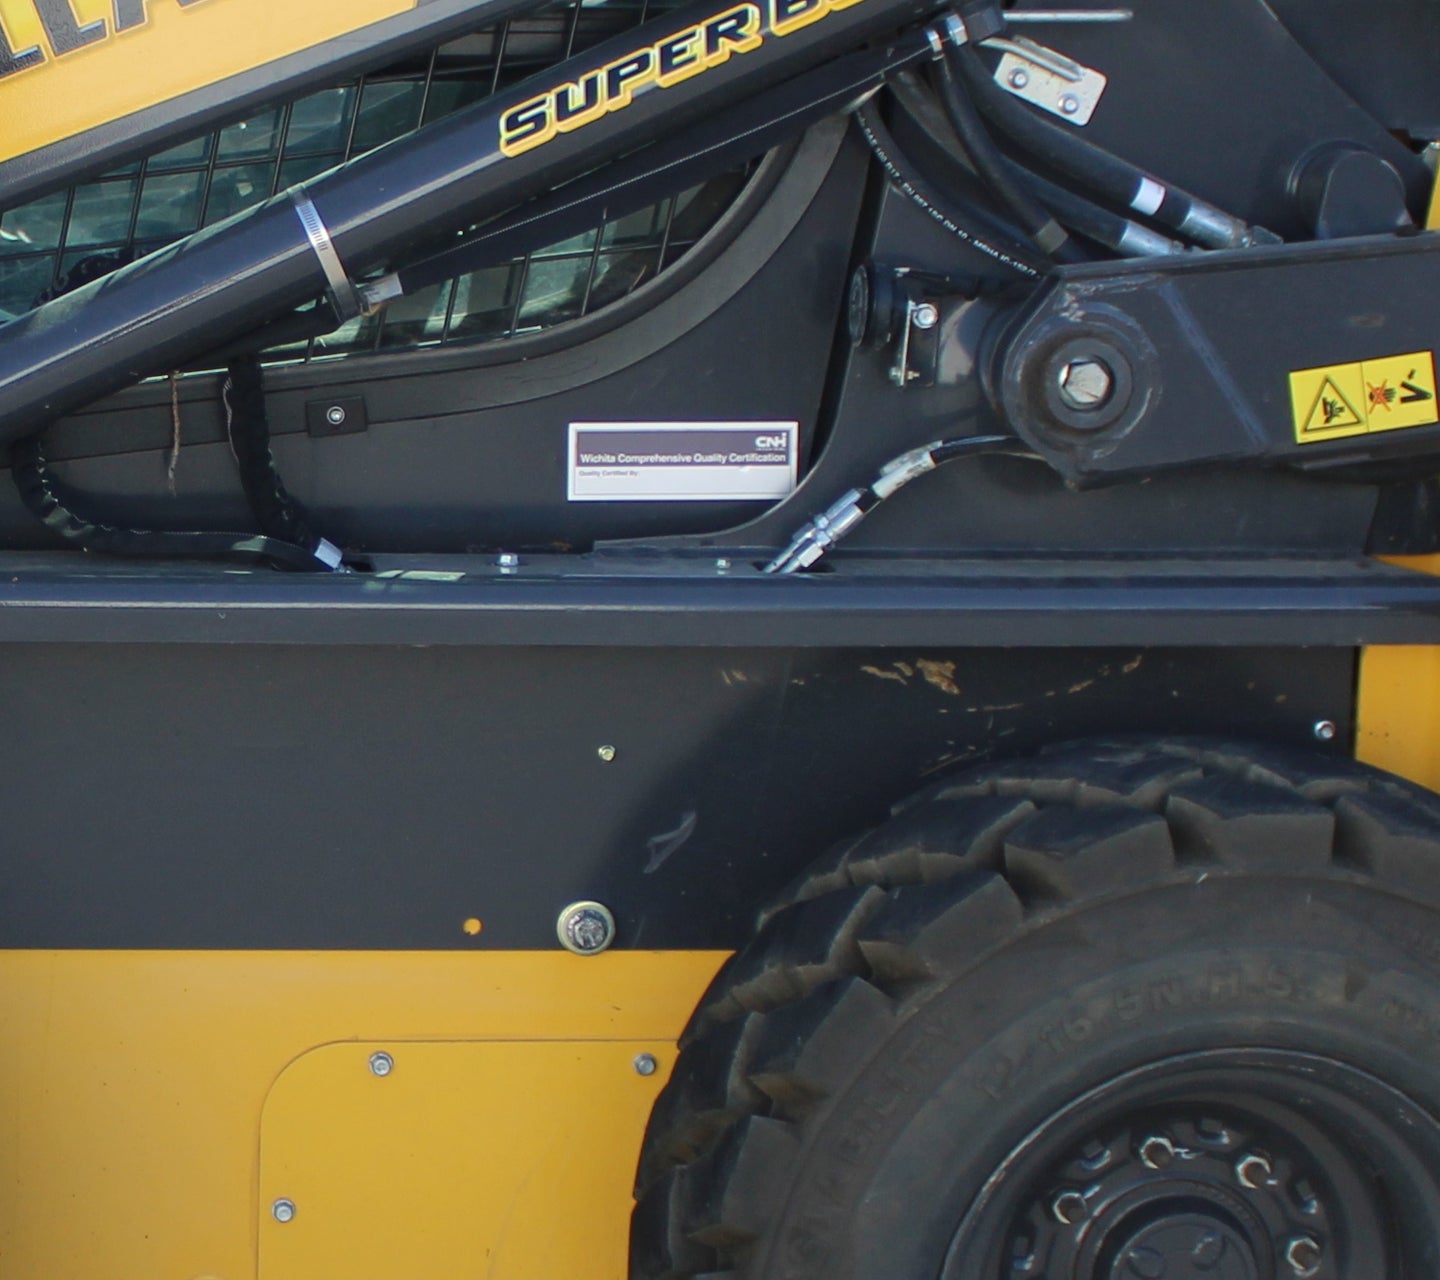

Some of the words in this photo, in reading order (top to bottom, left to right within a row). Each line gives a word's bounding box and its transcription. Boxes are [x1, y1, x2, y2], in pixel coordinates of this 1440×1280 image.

[500, 2, 763, 157] SUPER
[580, 453, 616, 464] Wichita
[617, 453, 692, 465] Comprehensive
[693, 453, 727, 465] Quality
[728, 452, 787, 464] Certification
